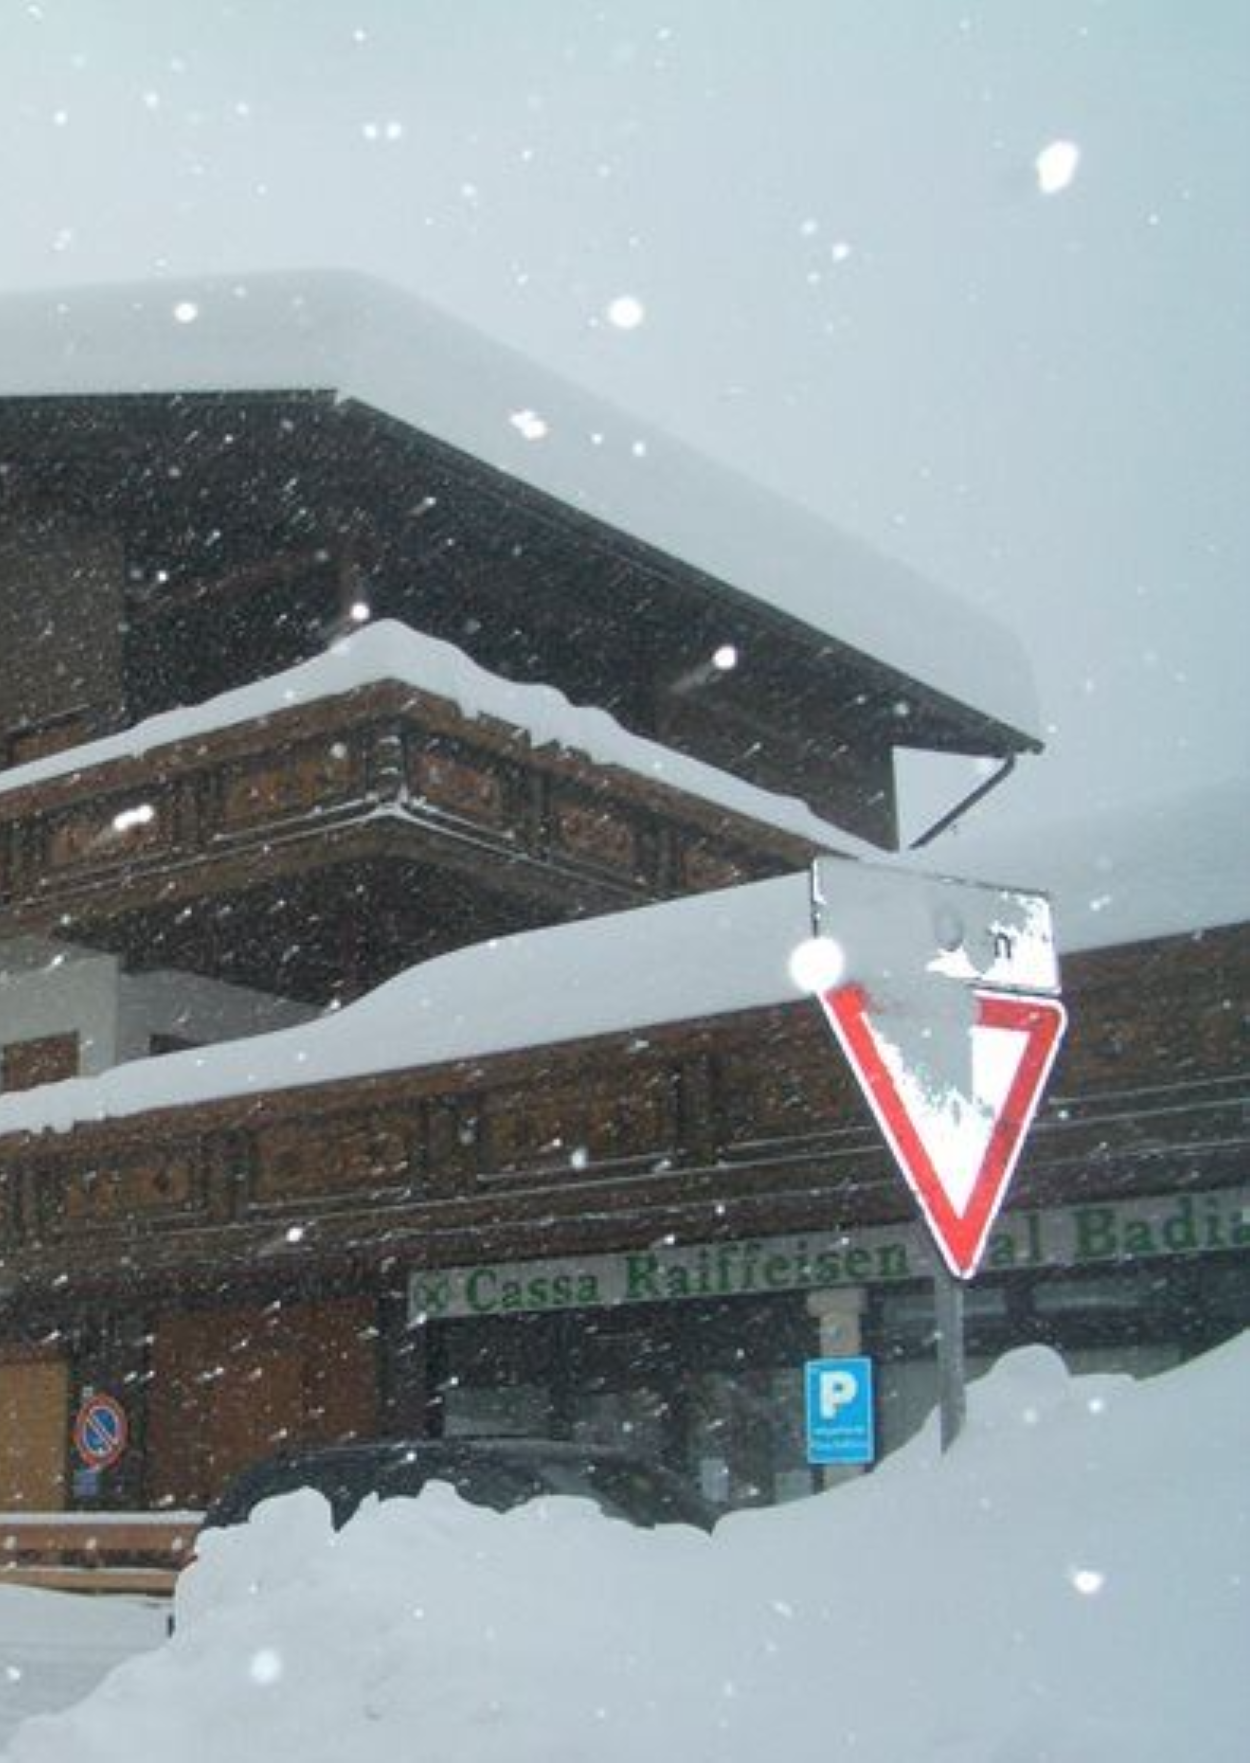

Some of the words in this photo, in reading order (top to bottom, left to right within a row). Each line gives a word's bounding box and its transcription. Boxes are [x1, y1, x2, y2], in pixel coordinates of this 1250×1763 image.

[465, 1268, 600, 1312] Cassa
[625, 1240, 910, 1298] Raiffeisen
[988, 1212, 1042, 1266] al
[819, 1371, 858, 1420] P
